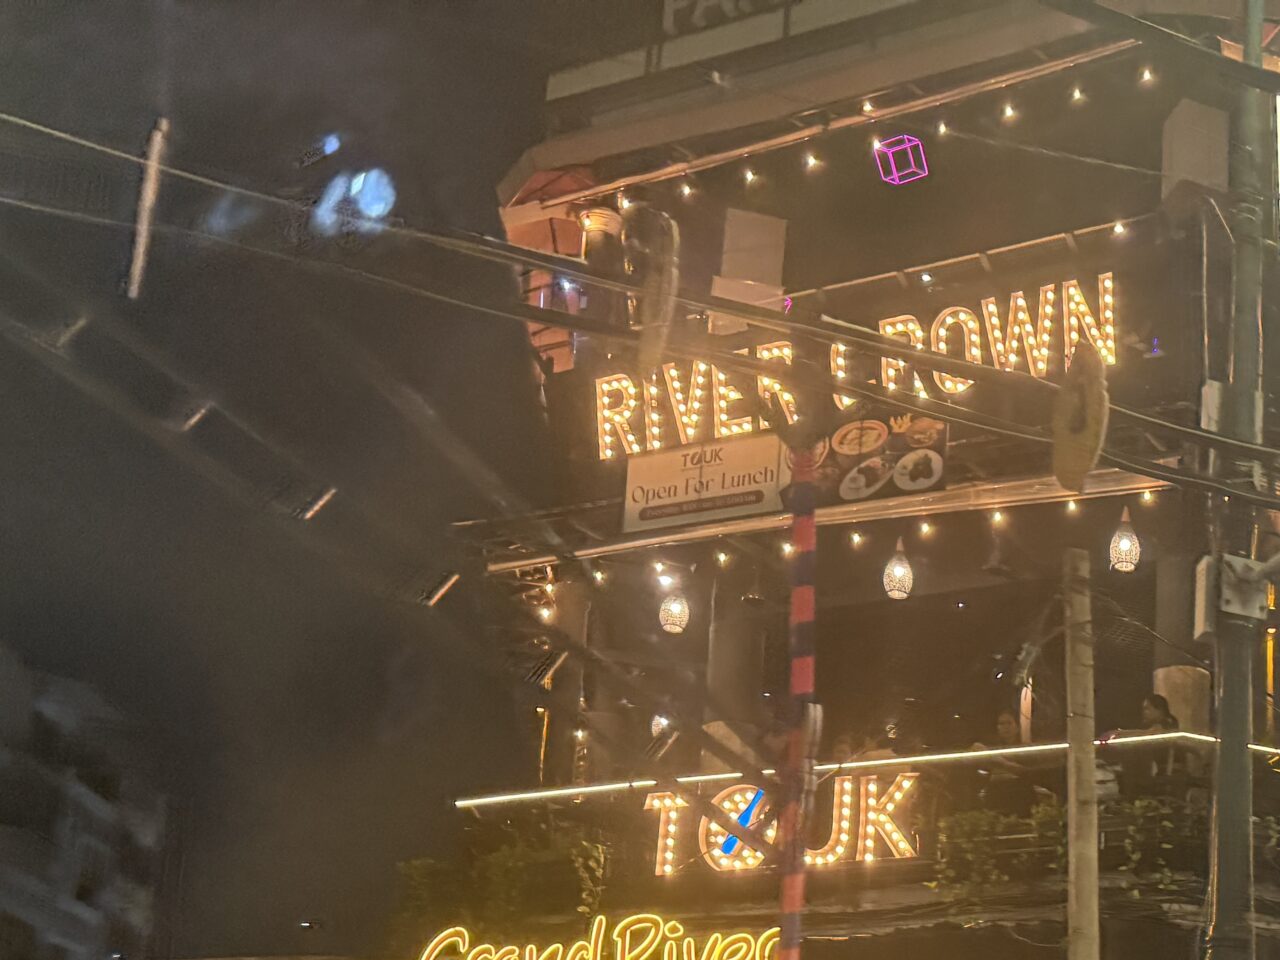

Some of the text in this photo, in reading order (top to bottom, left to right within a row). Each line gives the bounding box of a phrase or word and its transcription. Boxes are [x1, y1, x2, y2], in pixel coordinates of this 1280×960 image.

[631, 466, 775, 505] Open For Lunch
